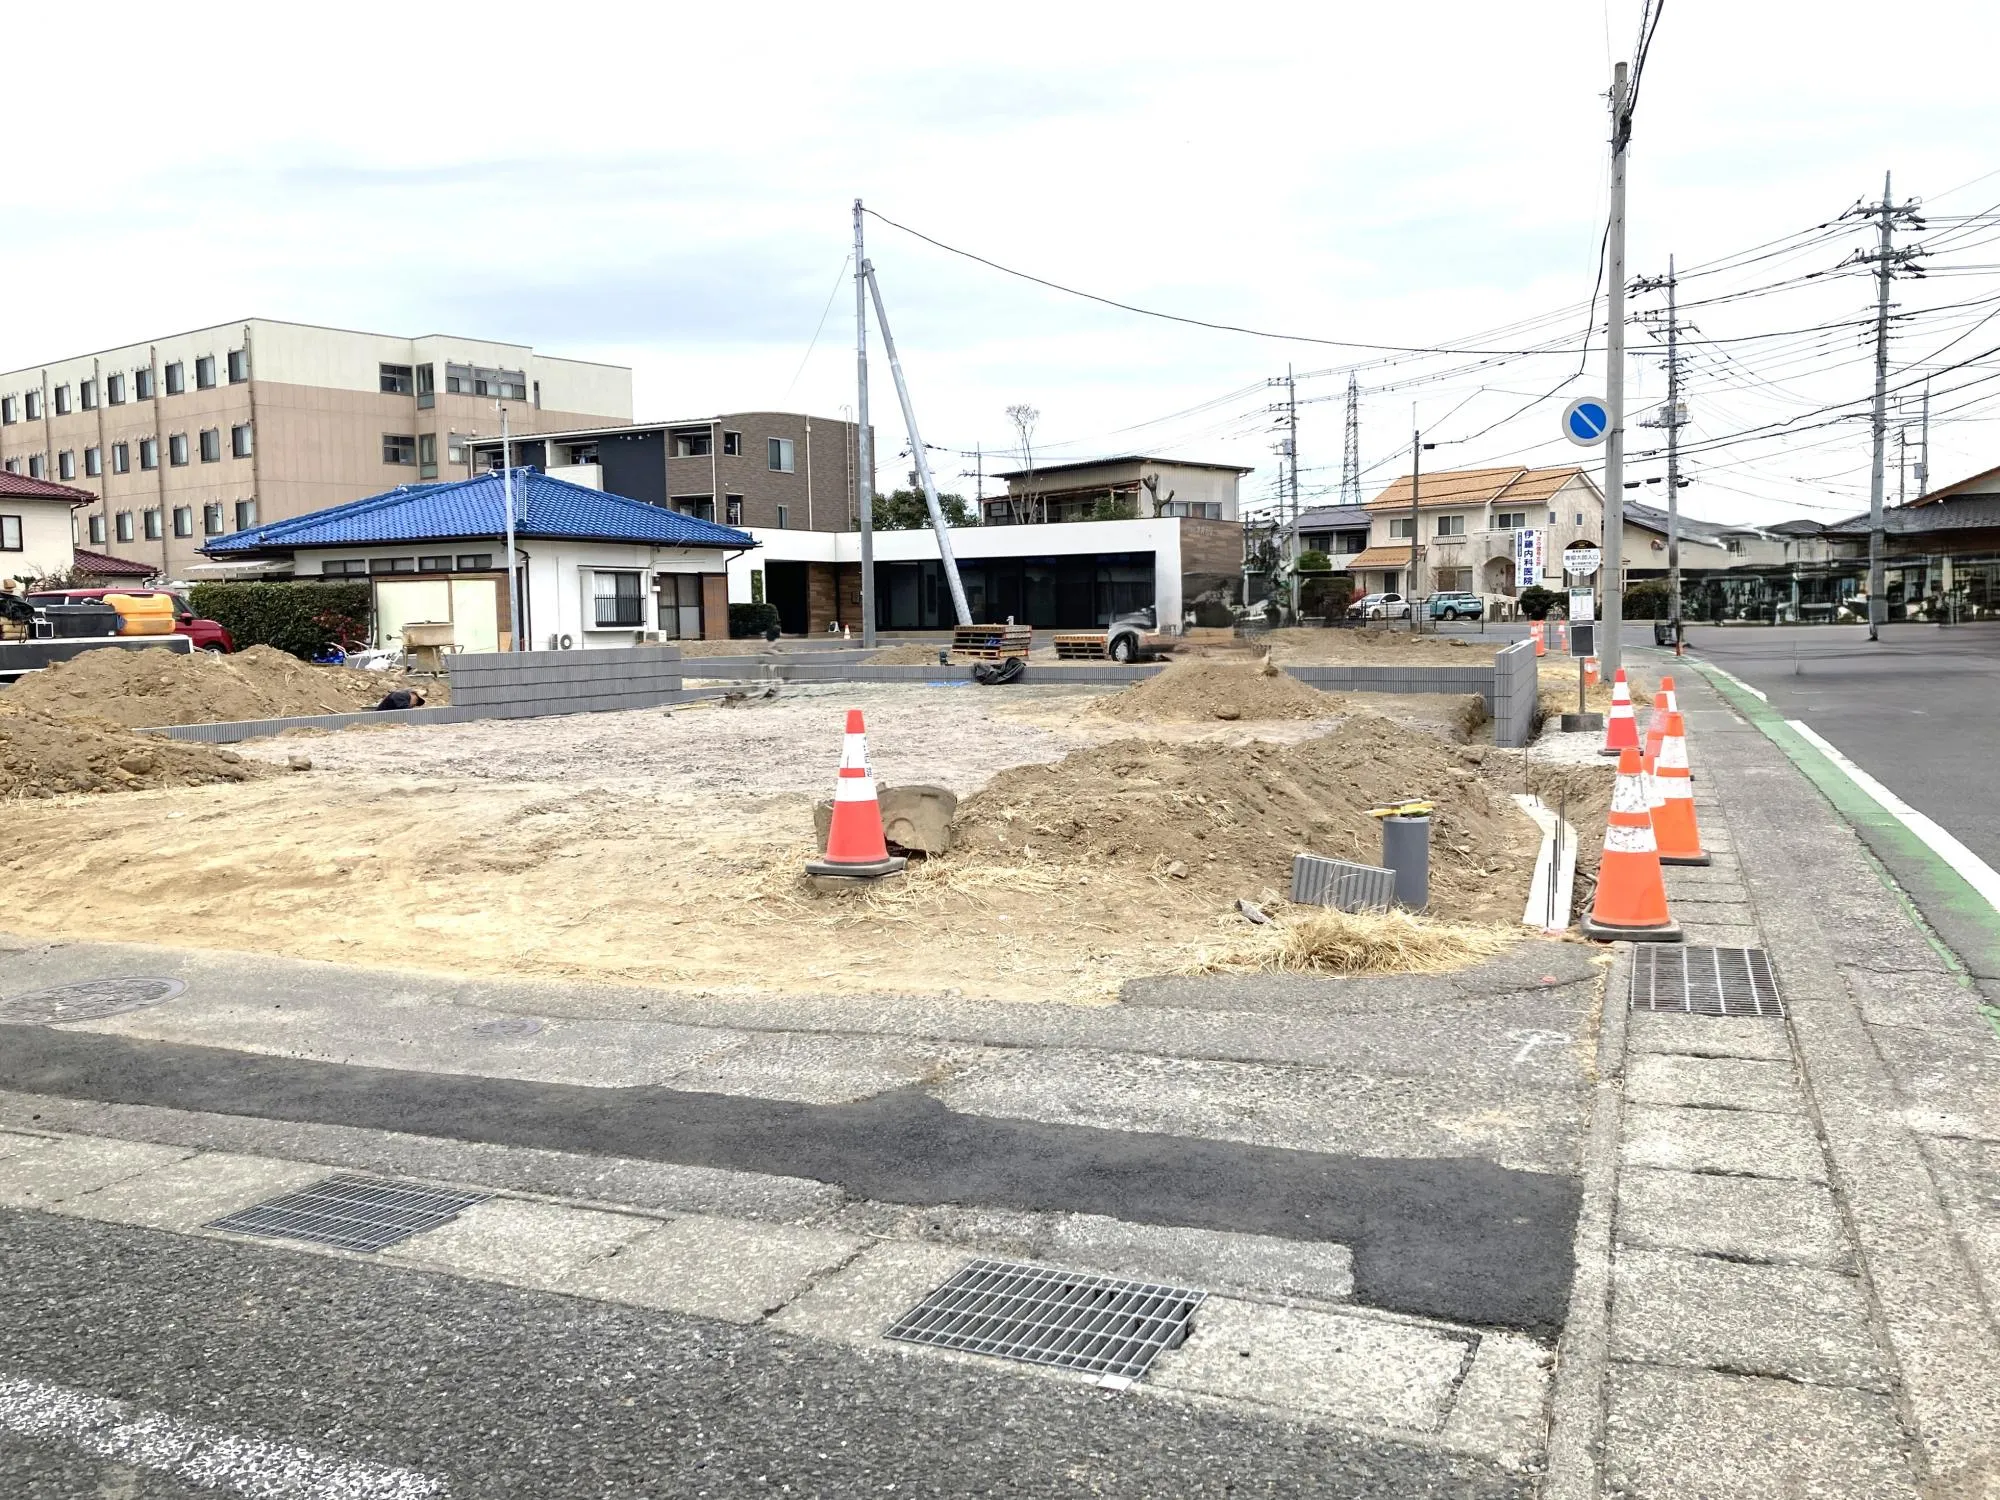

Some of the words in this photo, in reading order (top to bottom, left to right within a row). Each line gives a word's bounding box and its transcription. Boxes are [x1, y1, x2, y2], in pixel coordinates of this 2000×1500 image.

[1523, 530, 1534, 585] 伊藤内科医院
